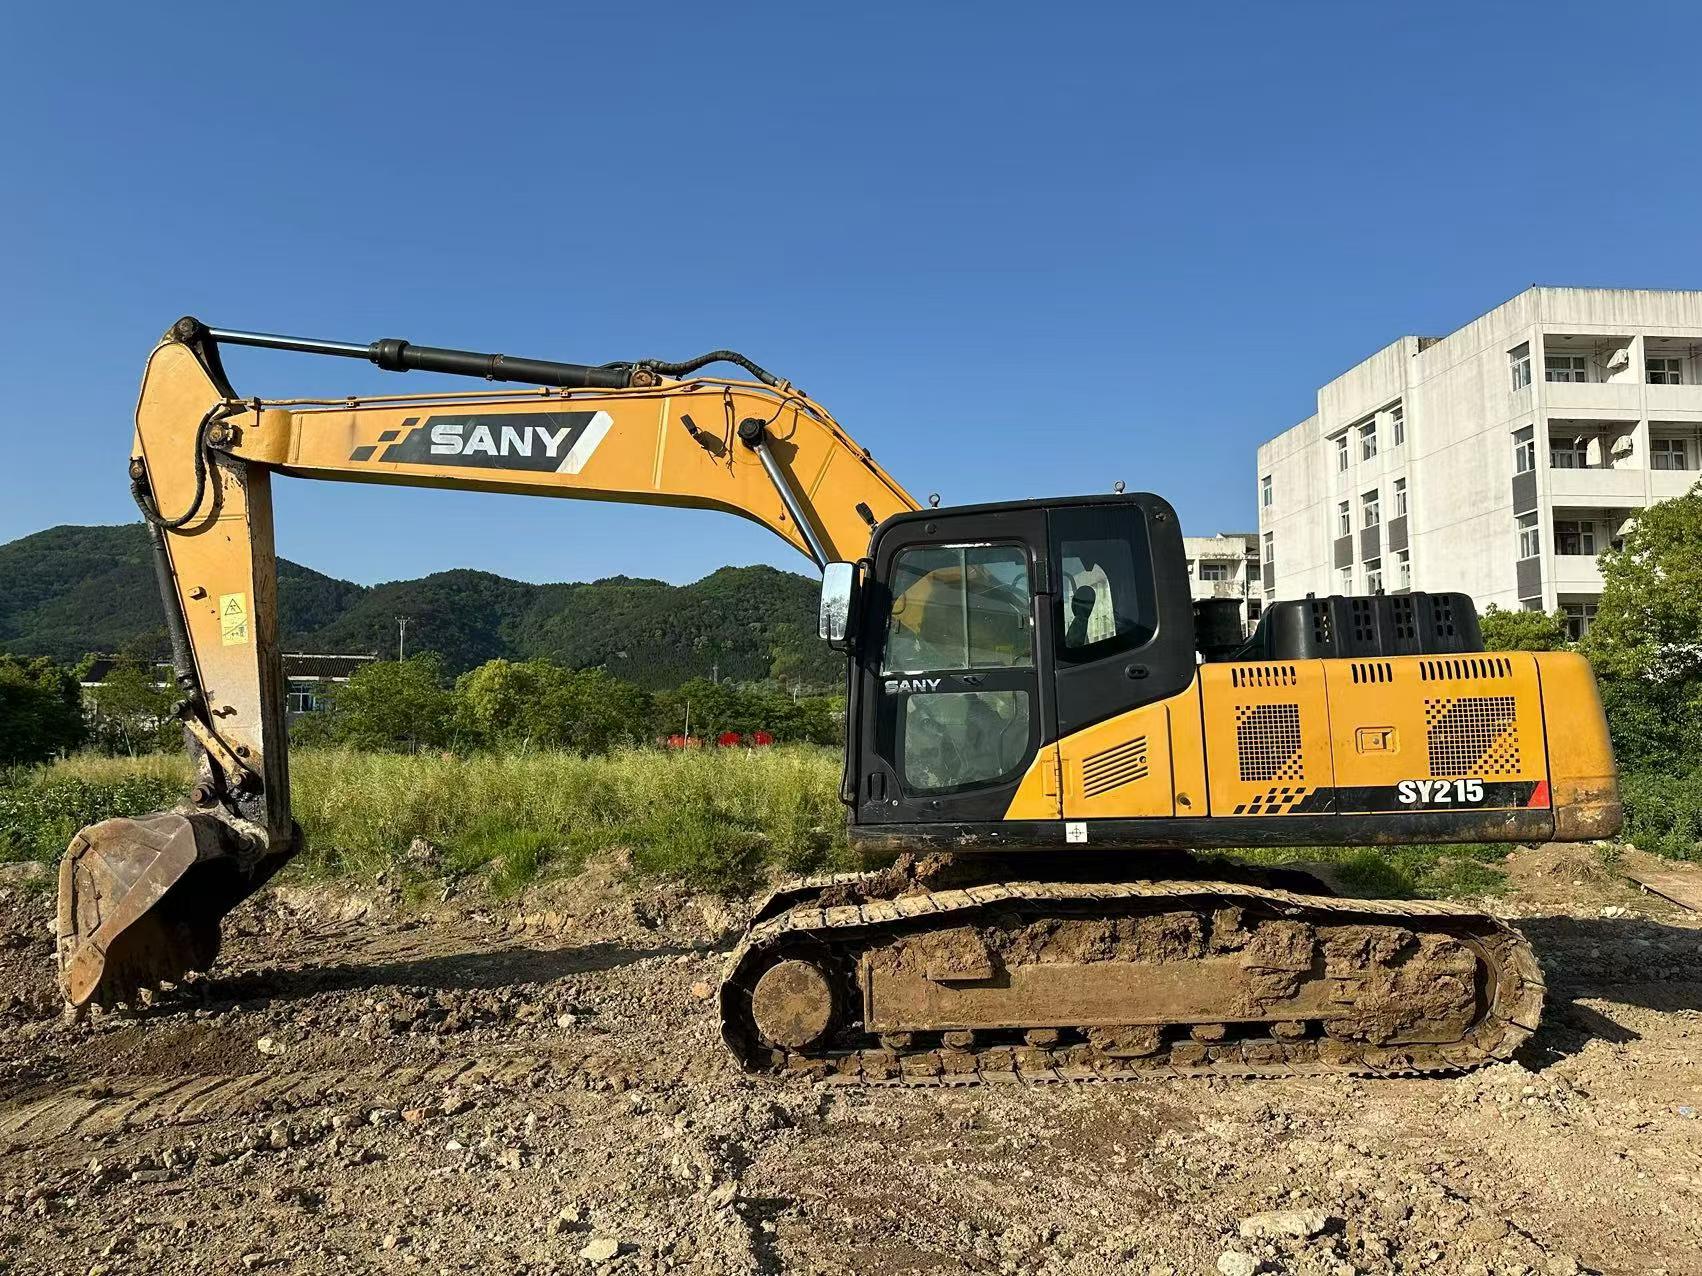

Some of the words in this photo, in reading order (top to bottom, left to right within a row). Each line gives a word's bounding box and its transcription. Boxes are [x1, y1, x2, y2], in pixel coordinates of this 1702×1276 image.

[430, 424, 572, 457] SANY
[884, 678, 941, 694] SANY
[1398, 779, 1484, 804] SY215
